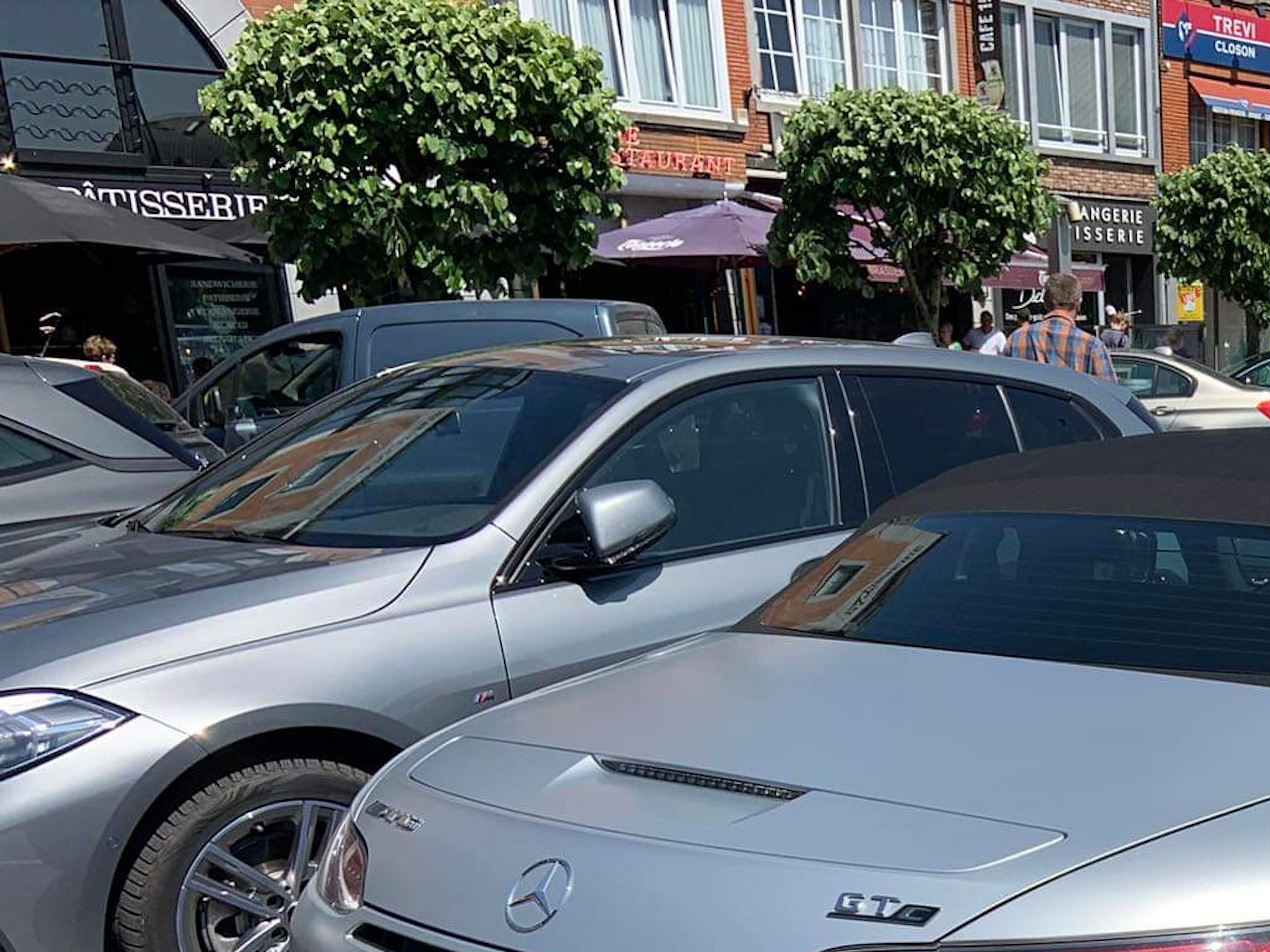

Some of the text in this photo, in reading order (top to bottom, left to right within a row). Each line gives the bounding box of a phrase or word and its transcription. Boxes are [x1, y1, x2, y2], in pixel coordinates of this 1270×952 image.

[977, 14, 995, 52] CAFE
[1212, 14, 1256, 39] TREVI
[1214, 40, 1256, 59] CLOSON
[610, 147, 736, 176] STAURANT
[57, 180, 268, 221] ÂTISSERIE
[1080, 205, 1143, 225] ANGERIE
[1075, 225, 1144, 245] ISSERIE
